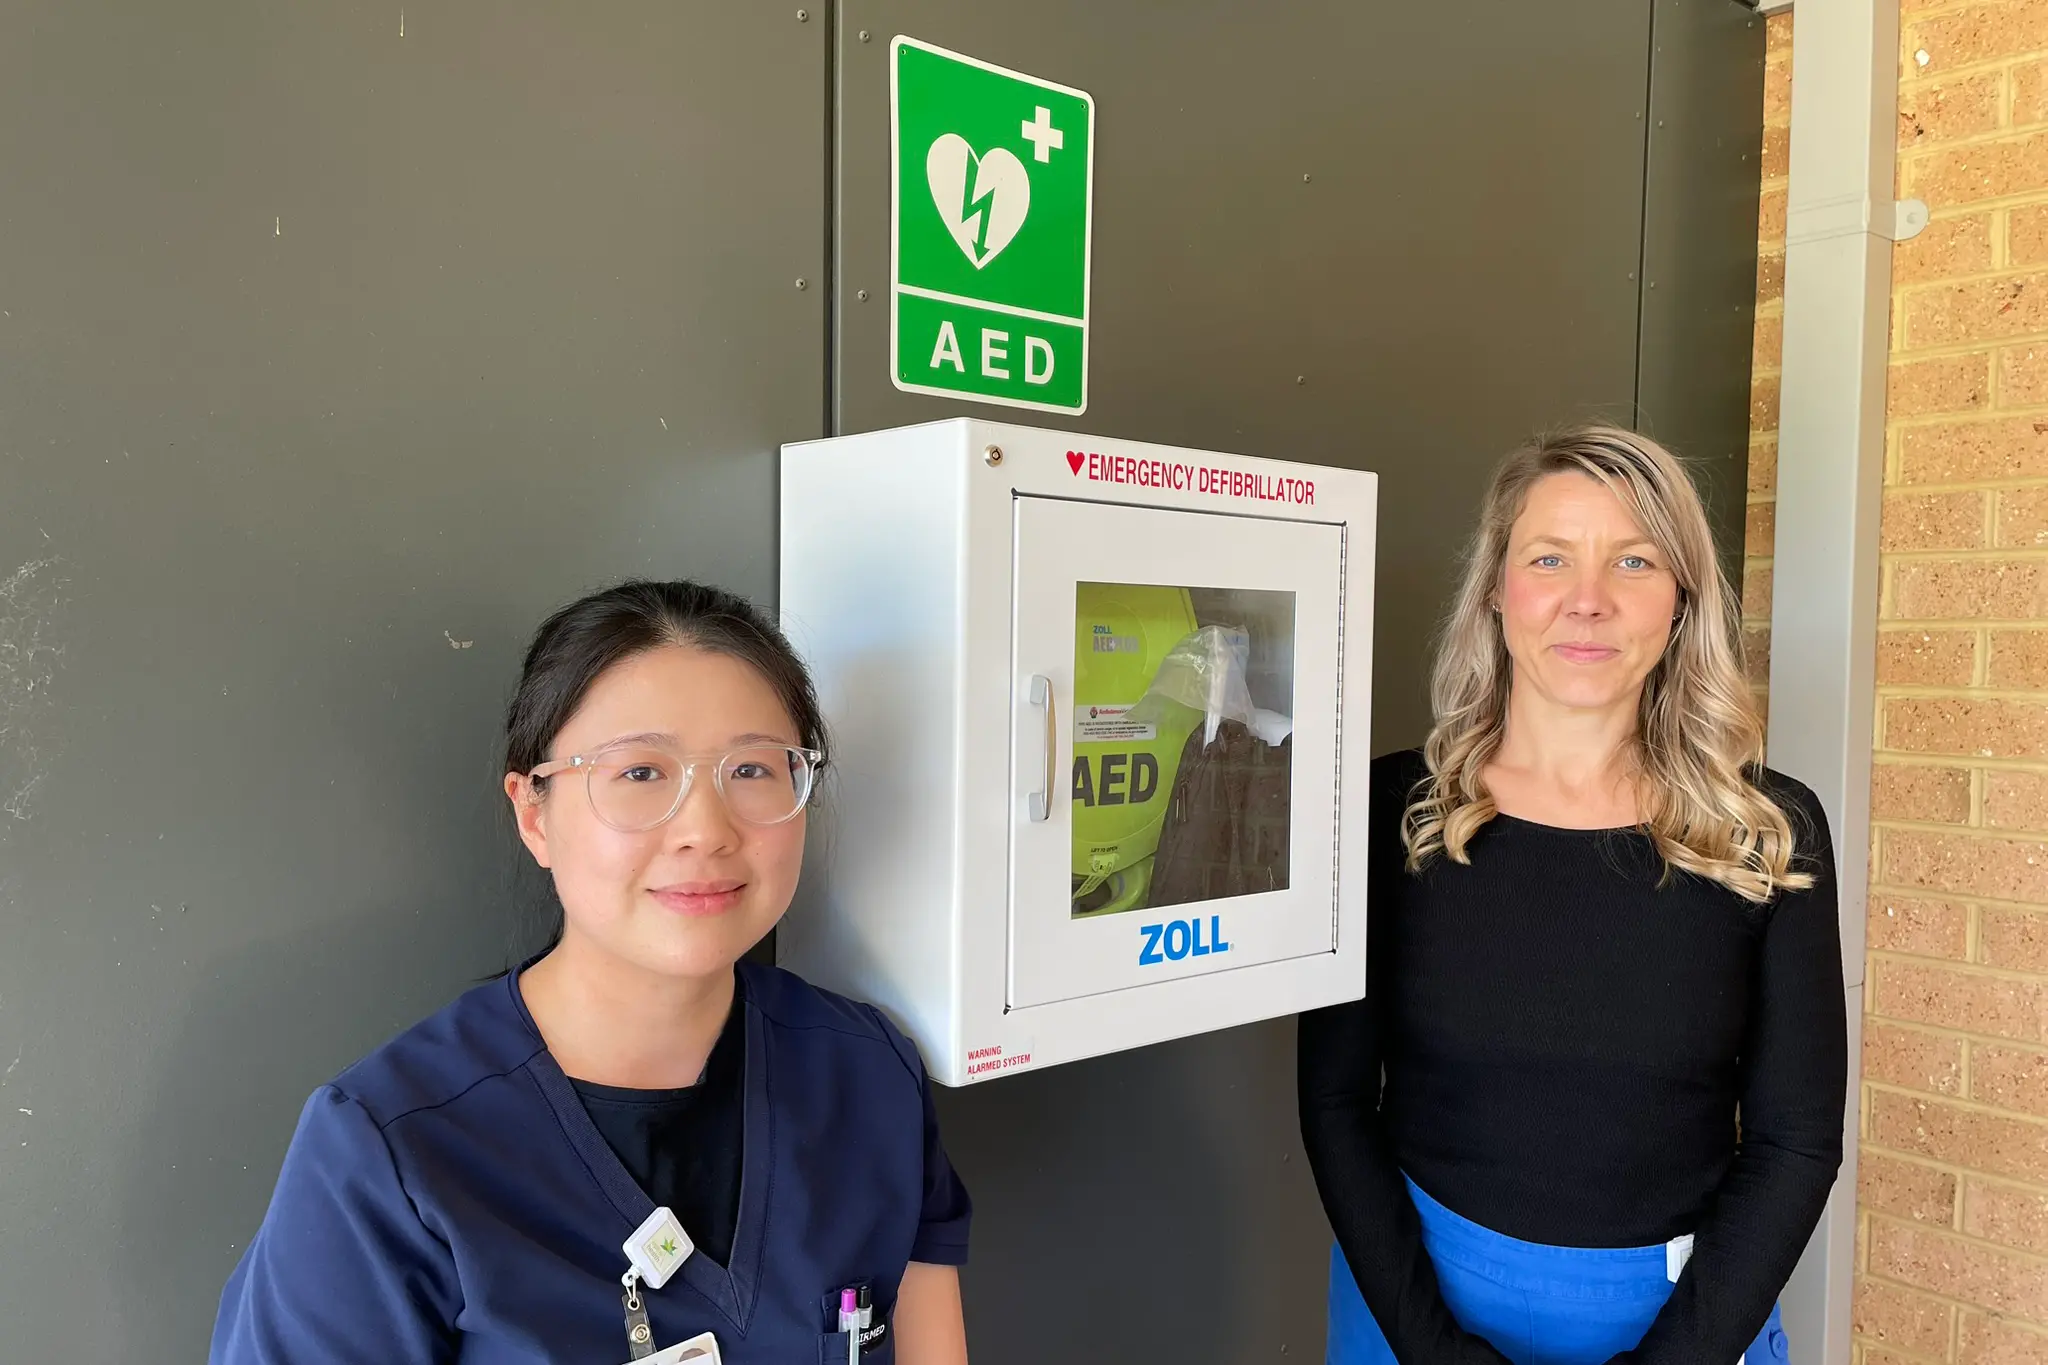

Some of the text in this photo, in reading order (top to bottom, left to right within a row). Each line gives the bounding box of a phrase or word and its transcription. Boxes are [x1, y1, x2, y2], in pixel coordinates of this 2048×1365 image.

[930, 320, 1055, 385] AED
[1089, 453, 1315, 505] EMERGENCY DEFIBRILLATOR
[1092, 625, 1112, 634] ZOLL
[1072, 753, 1158, 807] AED
[1139, 915, 1228, 966] ZOLL
[967, 1053, 1031, 1075] ALARMED SYSTEM
[968, 1045, 1002, 1061] WARNING
